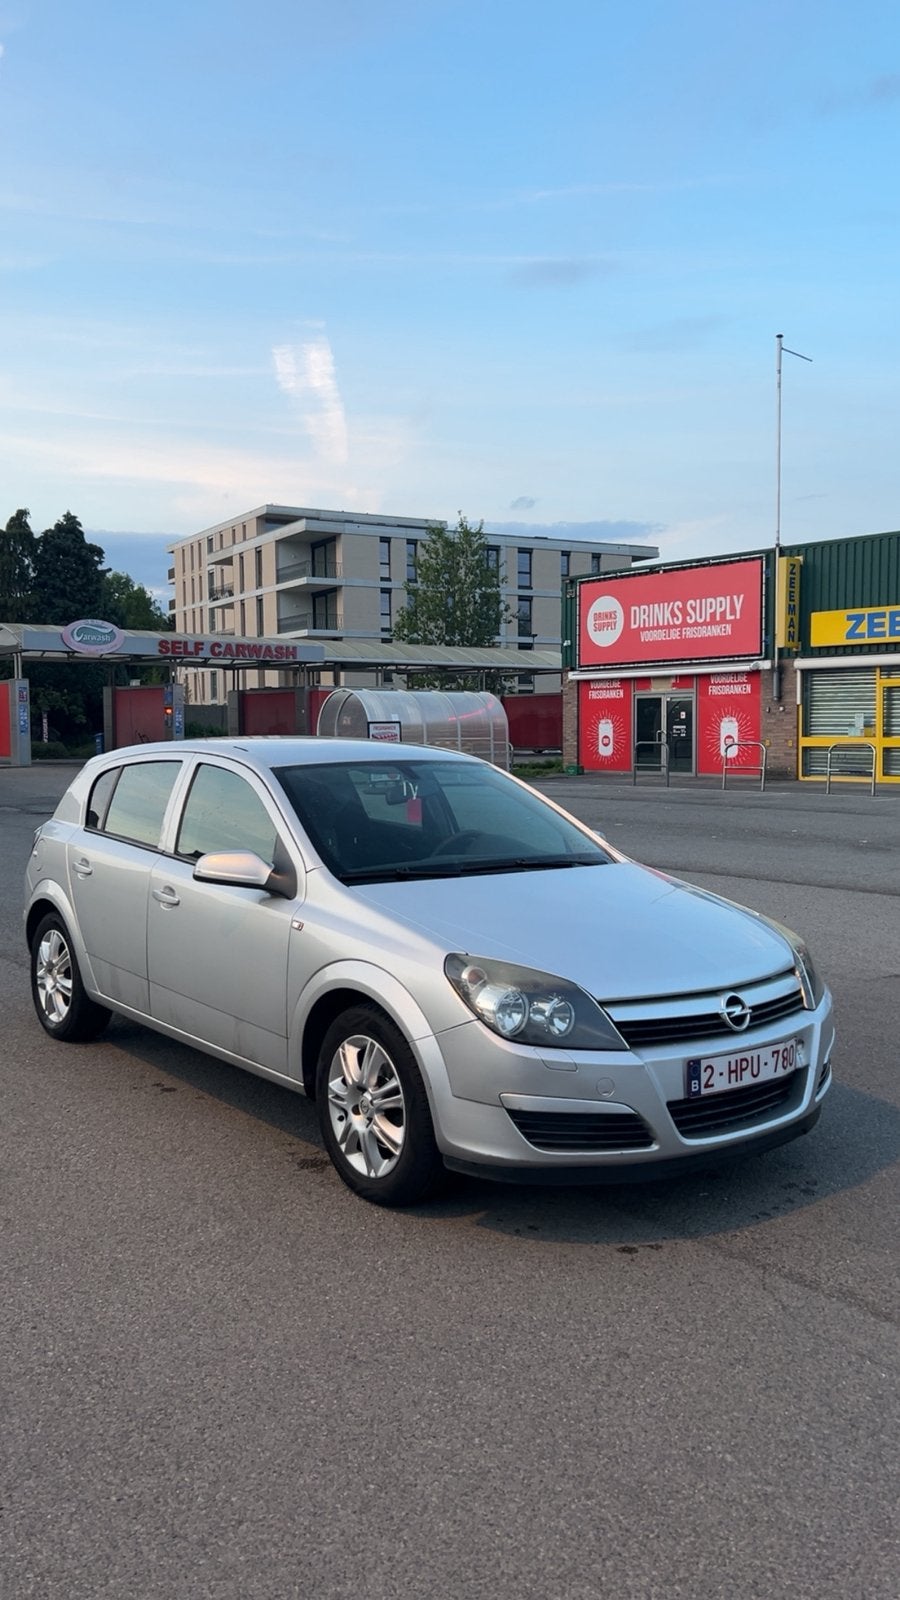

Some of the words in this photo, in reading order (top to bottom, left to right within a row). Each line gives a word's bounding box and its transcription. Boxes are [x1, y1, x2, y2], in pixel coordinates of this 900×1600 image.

[788, 563, 796, 642] ZEEMAN
[593, 610, 617, 622] DRINKS
[630, 601, 682, 629] DRINKS
[686, 594, 744, 624] SUPPLY
[593, 621, 617, 632] SUPPLY
[640, 628, 681, 642] VOORDELIGE
[682, 623, 731, 639] FRISDRANKEN
[158, 640, 204, 656] SELF
[210, 642, 297, 659] CARWASH
[710, 673, 747, 684] VOORDELIGE
[588, 689, 624, 699] FRISDRANKEN
[708, 684, 751, 696] FRISDRANKEN
[703, 1045, 795, 1089] 2-HPU-780
[691, 1080, 699, 1092] B
